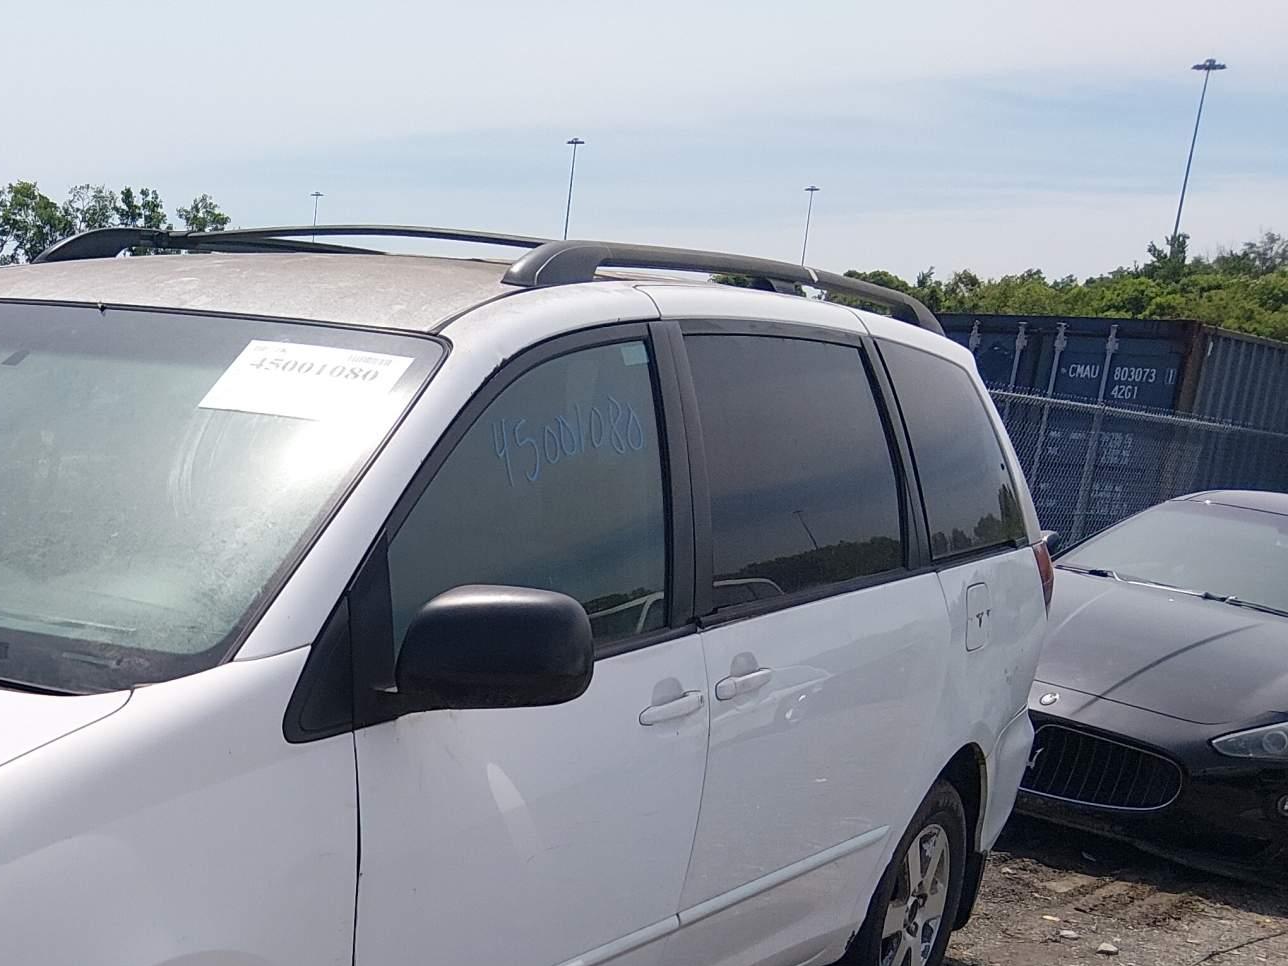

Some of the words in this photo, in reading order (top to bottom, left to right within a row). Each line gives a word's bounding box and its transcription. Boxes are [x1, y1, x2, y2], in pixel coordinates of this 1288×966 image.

[248, 356, 380, 382] 45001080
[1068, 363, 1100, 379] CMAU
[1113, 366, 1157, 383] 803073
[492, 393, 644, 488] 45001080
